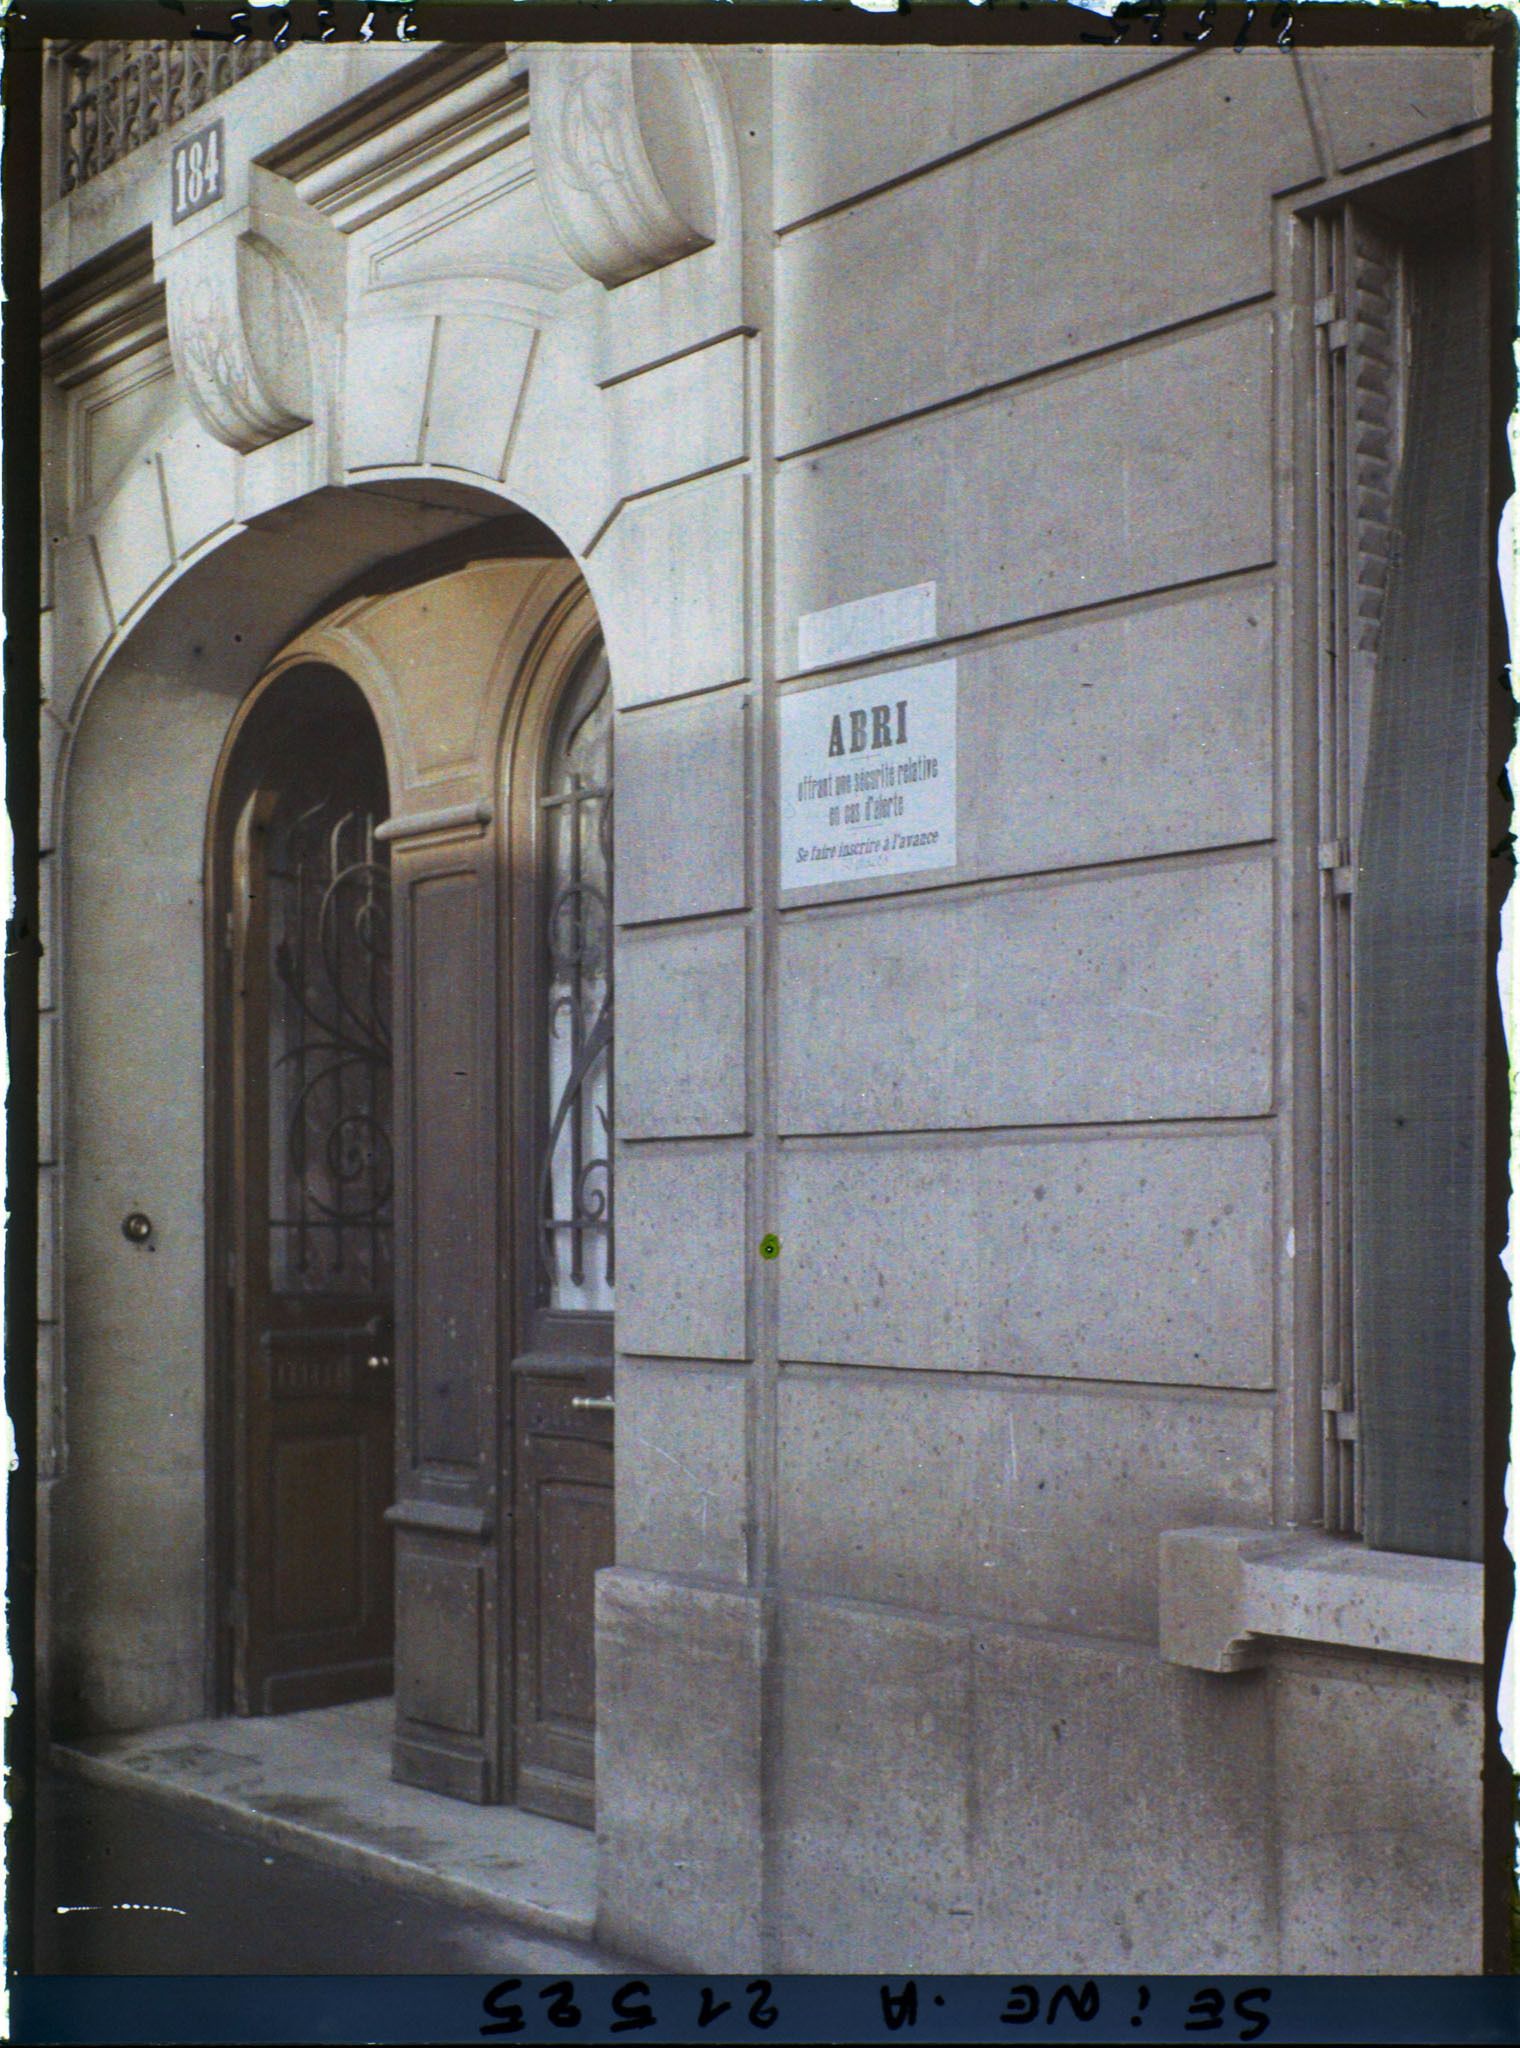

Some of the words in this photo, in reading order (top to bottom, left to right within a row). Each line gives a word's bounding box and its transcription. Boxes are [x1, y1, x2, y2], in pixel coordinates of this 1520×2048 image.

[175, 130, 220, 213] 184
[828, 700, 908, 757] ABRI
[798, 772, 833, 802] offrant
[897, 754, 939, 785] relative
[828, 805, 840, 827] en
[796, 847, 809, 863] Se
[810, 843, 837, 861] faire
[838, 838, 881, 858] inscrire
[891, 830, 939, 850] l'avance
